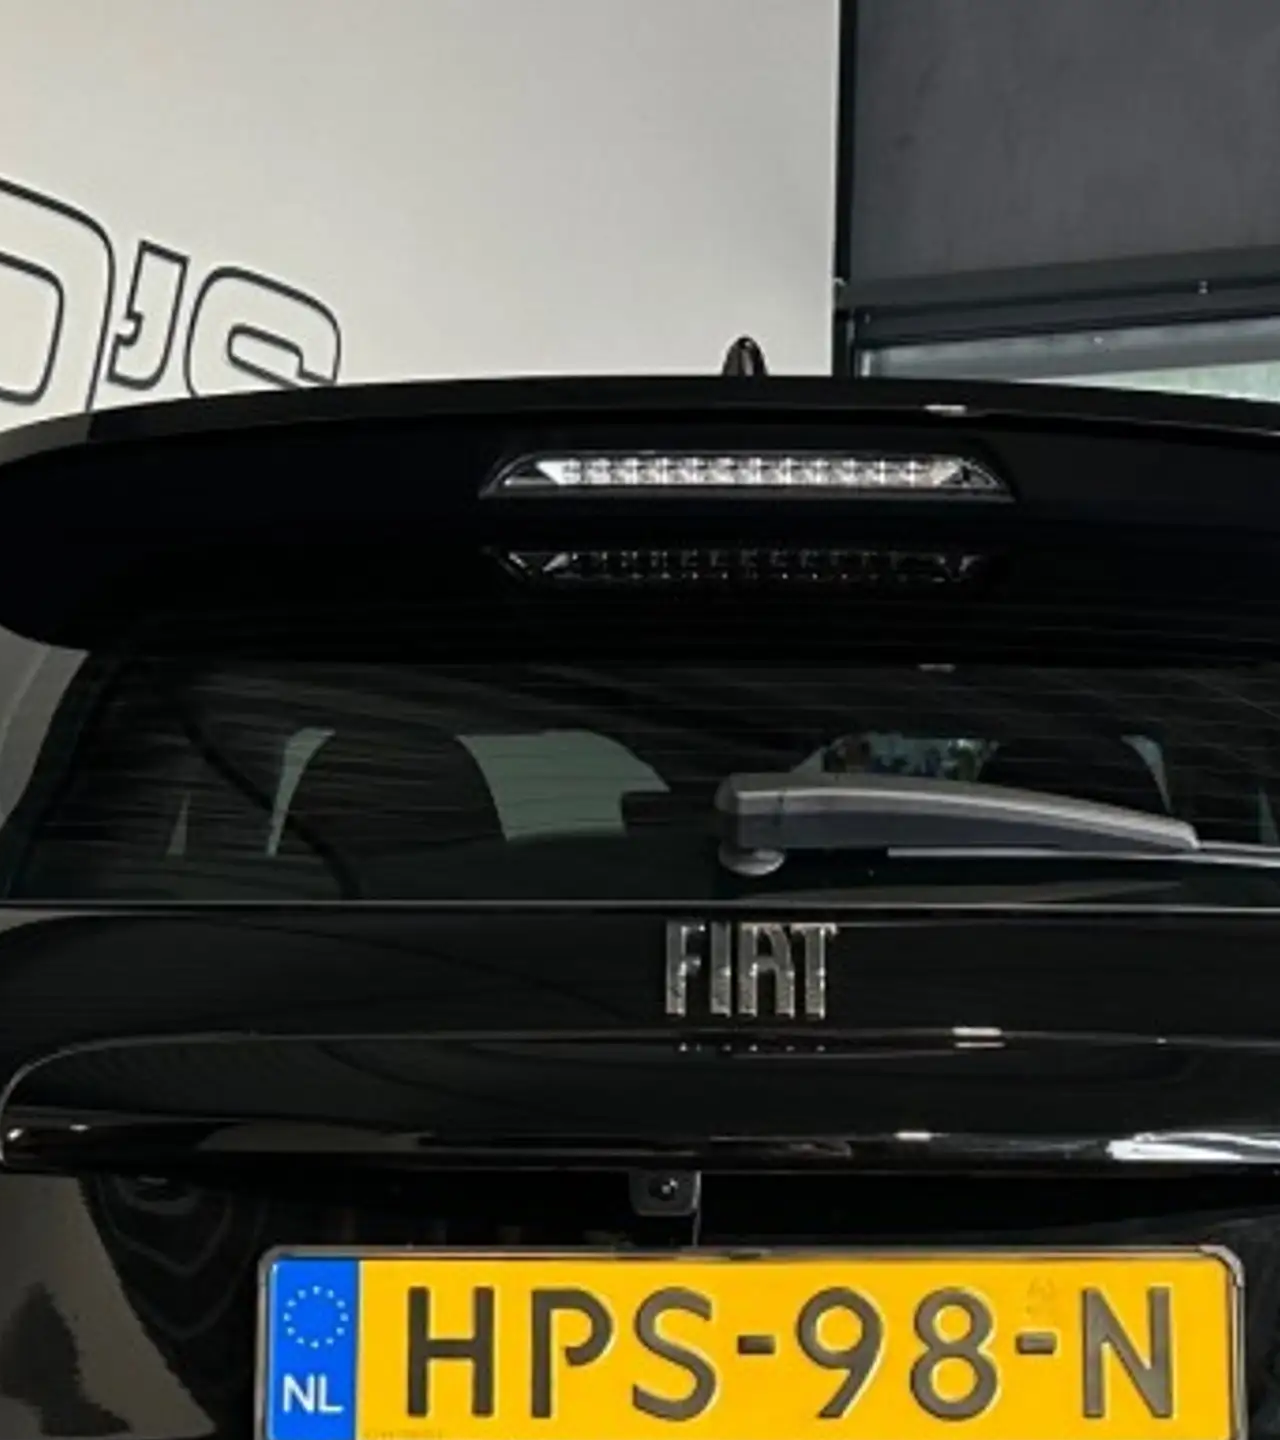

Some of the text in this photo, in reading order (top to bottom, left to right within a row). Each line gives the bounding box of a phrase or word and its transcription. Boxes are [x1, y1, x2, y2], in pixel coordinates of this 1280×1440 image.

[665, 921, 838, 1018] FIAT
[283, 1373, 343, 1413] NL
[404, 1286, 1176, 1421] HPS-98-N
